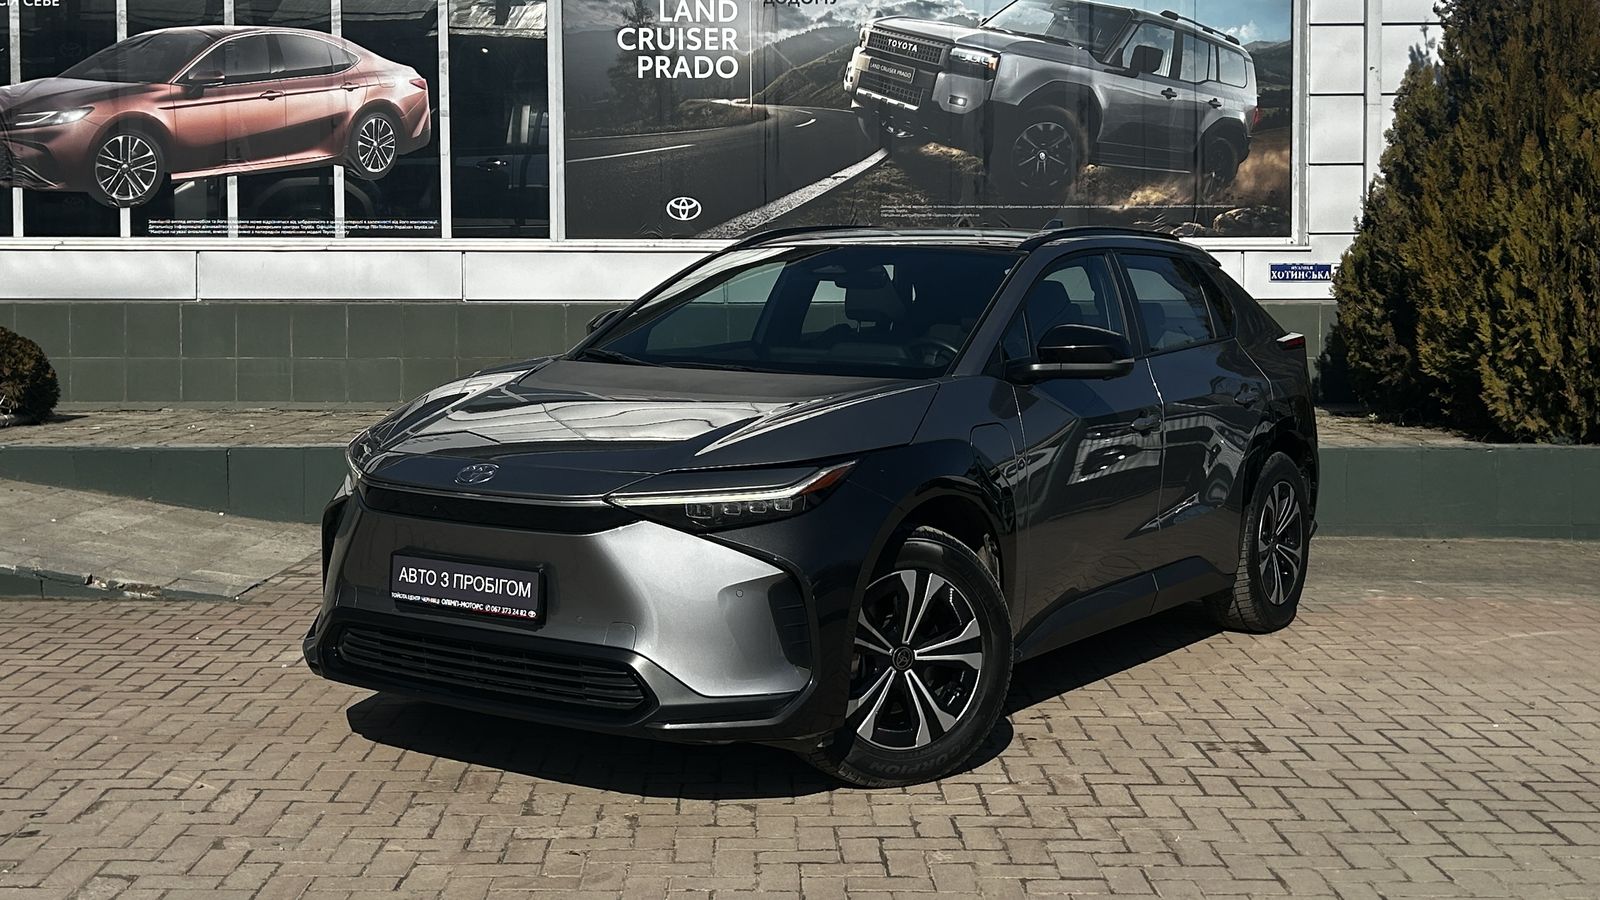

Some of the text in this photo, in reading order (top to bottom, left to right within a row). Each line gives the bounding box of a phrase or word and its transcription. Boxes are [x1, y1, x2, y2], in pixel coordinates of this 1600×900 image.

[659, 0, 738, 22] LAND
[616, 27, 739, 50] CRUISER
[887, 38, 918, 52] TOYOTA
[637, 56, 739, 79] PRADO
[870, 62, 912, 79] LAND CRUISER PRADO
[1271, 270, 1330, 279] ХОТИНСЬКА
[399, 566, 532, 598] АВТО З ПРОБІГОМ
